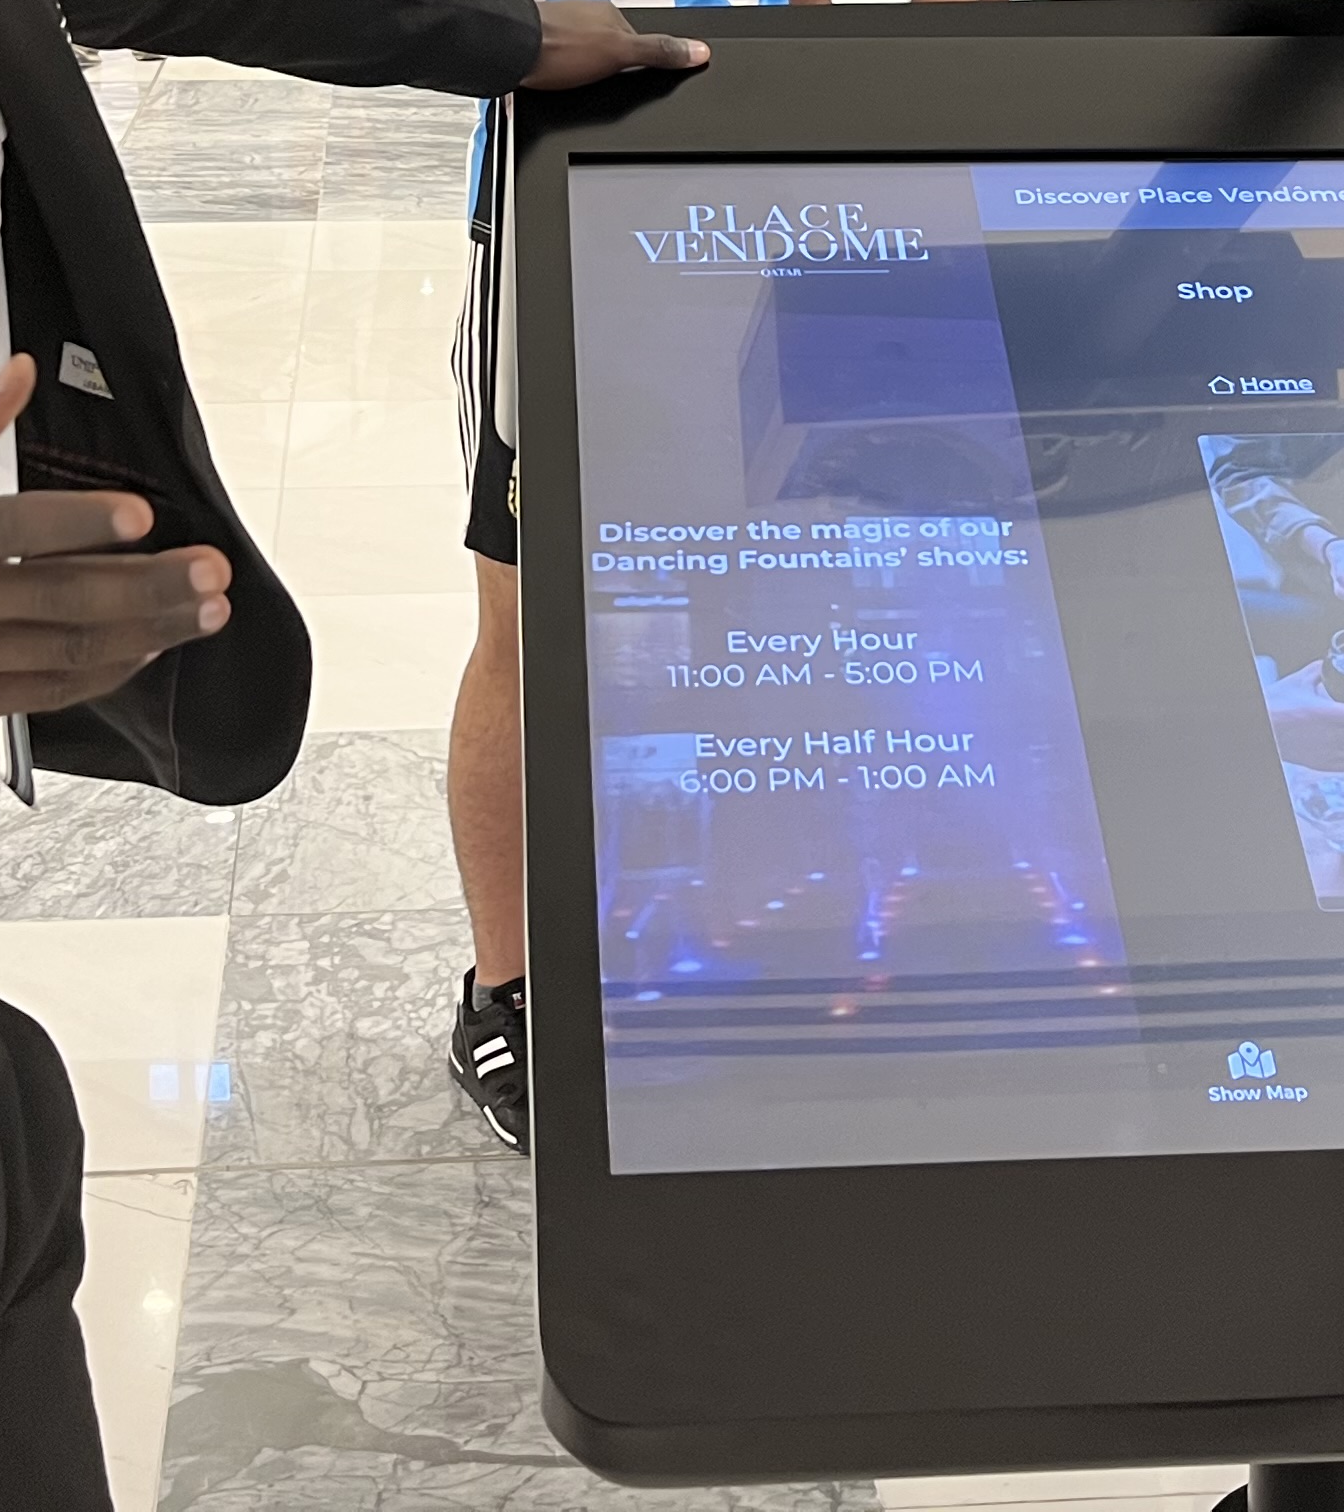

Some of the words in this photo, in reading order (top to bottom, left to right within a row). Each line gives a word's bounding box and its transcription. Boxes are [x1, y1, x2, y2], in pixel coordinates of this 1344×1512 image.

[1015, 186, 1129, 206] Discover
[1137, 185, 1213, 205] Place
[684, 203, 868, 233] PLACE
[760, 267, 802, 278] QATAR
[1176, 281, 1254, 304] Shop
[1240, 374, 1314, 393] Home
[599, 521, 739, 542] Discover
[746, 519, 802, 541] the
[811, 517, 912, 544] magic
[919, 516, 954, 538] of
[959, 519, 1014, 538] our
[591, 551, 729, 575] Dancing
[739, 546, 908, 570] Fountains'
[917, 546, 1030, 567] shows:
[727, 629, 823, 657] Every
[833, 628, 919, 652] Hour
[666, 663, 746, 688] 11:00
[754, 662, 812, 686] AM
[844, 660, 919, 685] 5:00
[928, 658, 985, 683] PM
[695, 733, 793, 761] Every
[804, 728, 876, 755] Half
[886, 729, 975, 754] Hour
[678, 768, 758, 794] 6:00
[768, 767, 826, 792] PM
[856, 764, 928, 790] 1:00
[937, 763, 996, 788] AM
[1208, 1085, 1262, 1102] Show
[1265, 1084, 1309, 1103] Map
